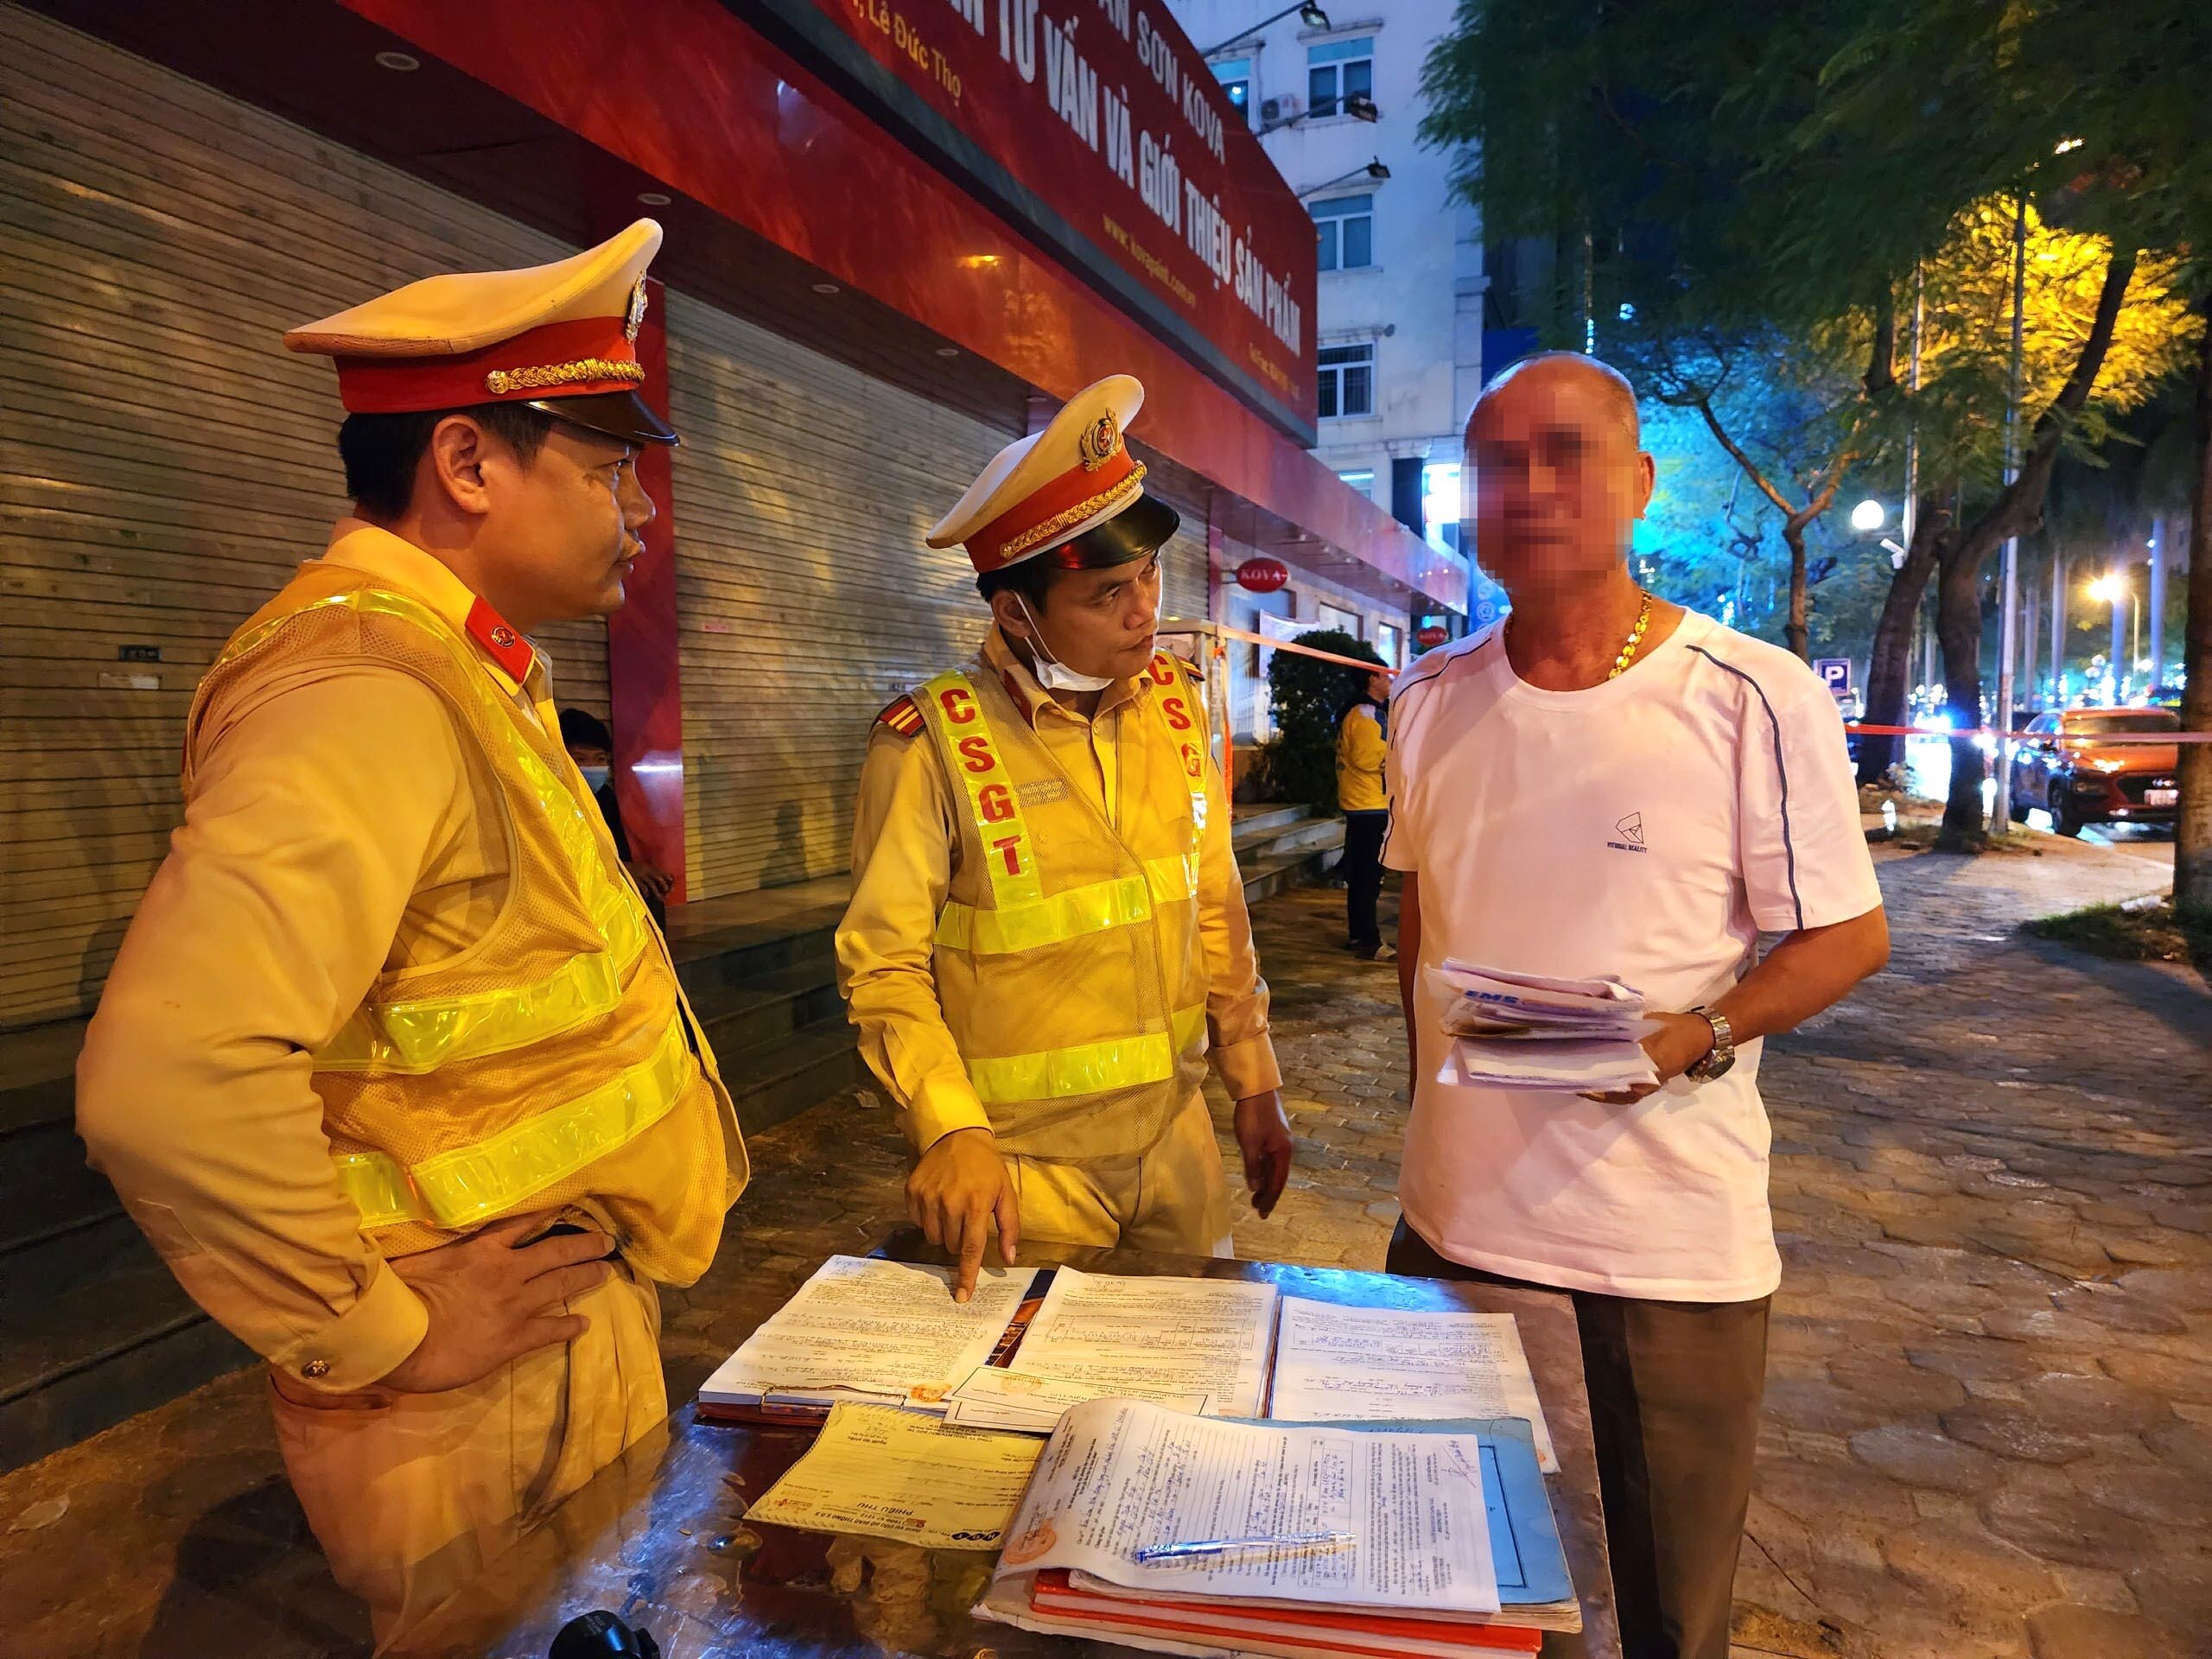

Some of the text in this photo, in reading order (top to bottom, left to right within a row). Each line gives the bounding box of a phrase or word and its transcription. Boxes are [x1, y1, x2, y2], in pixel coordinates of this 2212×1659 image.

[868, 0, 889, 35] Lê
[894, 12, 928, 70] Đức
[931, 47, 961, 107] Thọ
[1137, 10, 1178, 104] SƠN
[1183, 73, 1225, 165] KOVA
[1043, 15, 1098, 152] VẤN
[1103, 84, 1135, 189] VÀ
[1140, 130, 1181, 236] GIỚI
[1185, 177, 1231, 291] THIỆU
[1235, 225, 1264, 320] SẢN
[1266, 270, 1300, 358] PHẨM
[1241, 569, 1281, 581] KOVA
[1825, 665, 1844, 687] P
[939, 689, 1021, 876] CSGT
[1629, 844, 1647, 854] REALITY
